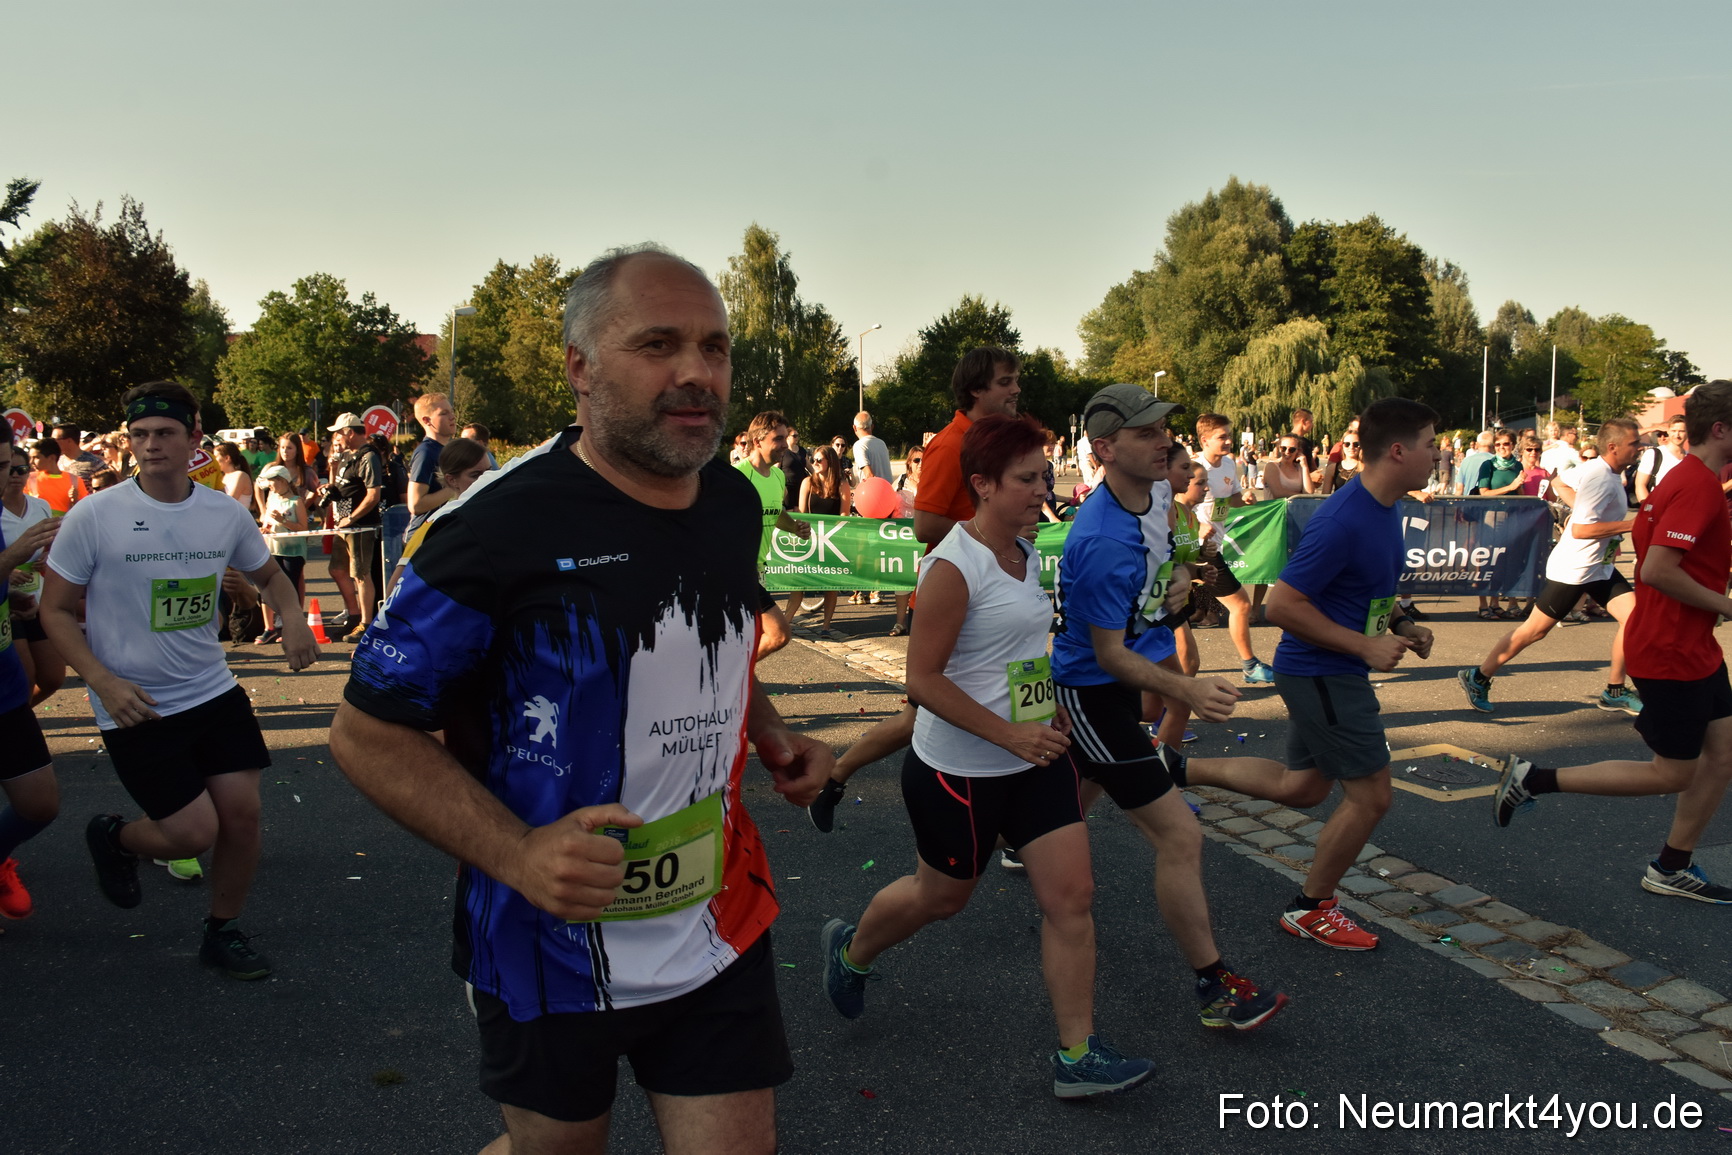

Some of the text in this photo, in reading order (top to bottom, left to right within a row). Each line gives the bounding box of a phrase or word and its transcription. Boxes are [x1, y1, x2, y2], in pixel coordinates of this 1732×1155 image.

[125, 550, 226, 563] RUPPRECHT HOLZBAU
[880, 551, 903, 573] in
[1405, 541, 1506, 568] scher
[1399, 571, 1494, 582] UTOMOBILE
[162, 593, 210, 617] 1755
[1020, 678, 1053, 707] 208
[655, 876, 705, 901] Bernhard
[602, 891, 694, 913] Autohaus Müller GmbH
